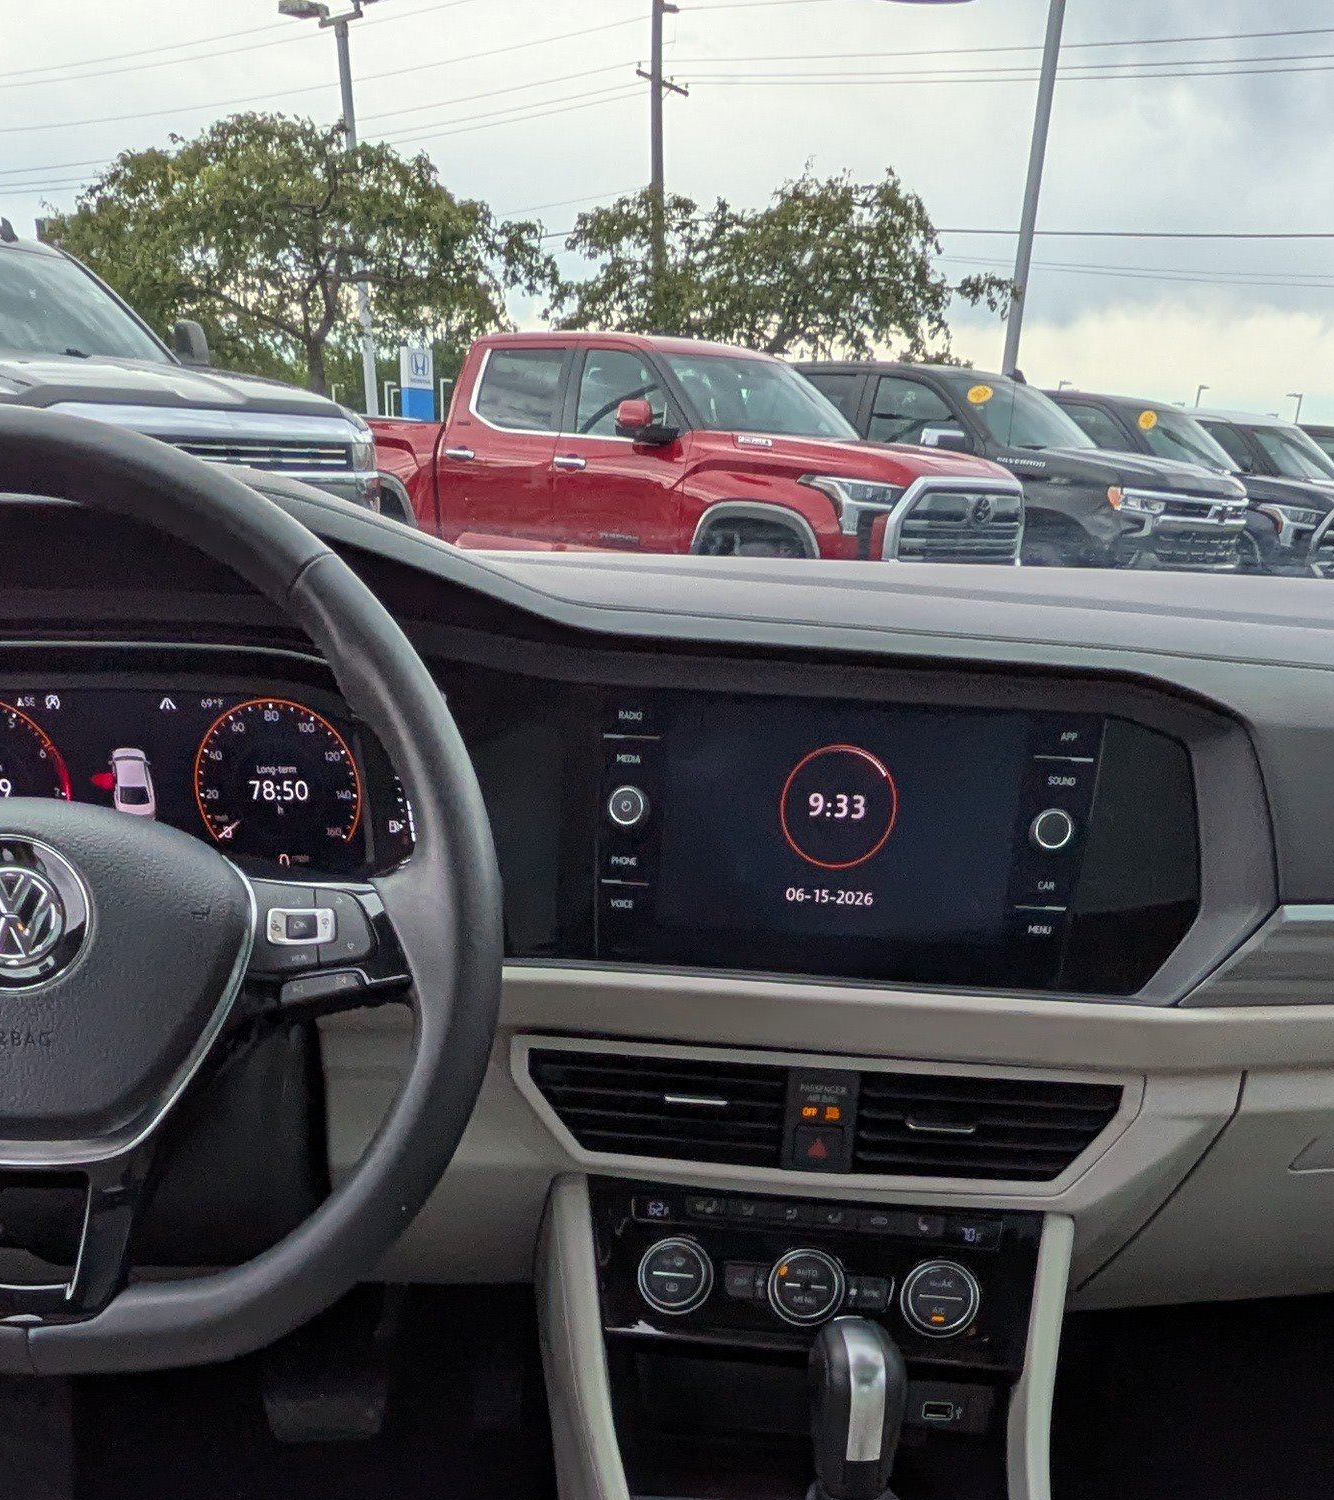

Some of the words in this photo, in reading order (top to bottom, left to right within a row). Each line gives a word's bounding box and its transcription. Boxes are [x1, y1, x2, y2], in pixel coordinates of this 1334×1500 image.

[263, 710, 280, 723] 80
[618, 710, 643, 721] RADIO
[9, 718, 15, 728] 5
[231, 722, 245, 733] 60
[297, 722, 315, 733] 100
[1060, 732, 1078, 742] APP
[39, 749, 46, 759] 6
[209, 750, 223, 761] 40
[324, 751, 341, 762] 120
[616, 754, 641, 764] MEDIA
[256, 764, 297, 775] Long-term
[1047, 775, 1076, 786] SOUND
[206, 789, 219, 800] 20
[248, 780, 309, 801] 78:50
[336, 789, 352, 800] 140
[808, 792, 865, 819] 9:33
[326, 827, 342, 837] 160
[610, 856, 637, 866] PHONE
[1037, 881, 1055, 891] CAR
[785, 887, 874, 906] 06-15-2026
[610, 899, 634, 909] VOICE
[1027, 925, 1051, 935] MENU
[796, 1268, 818, 1278] AUTO
